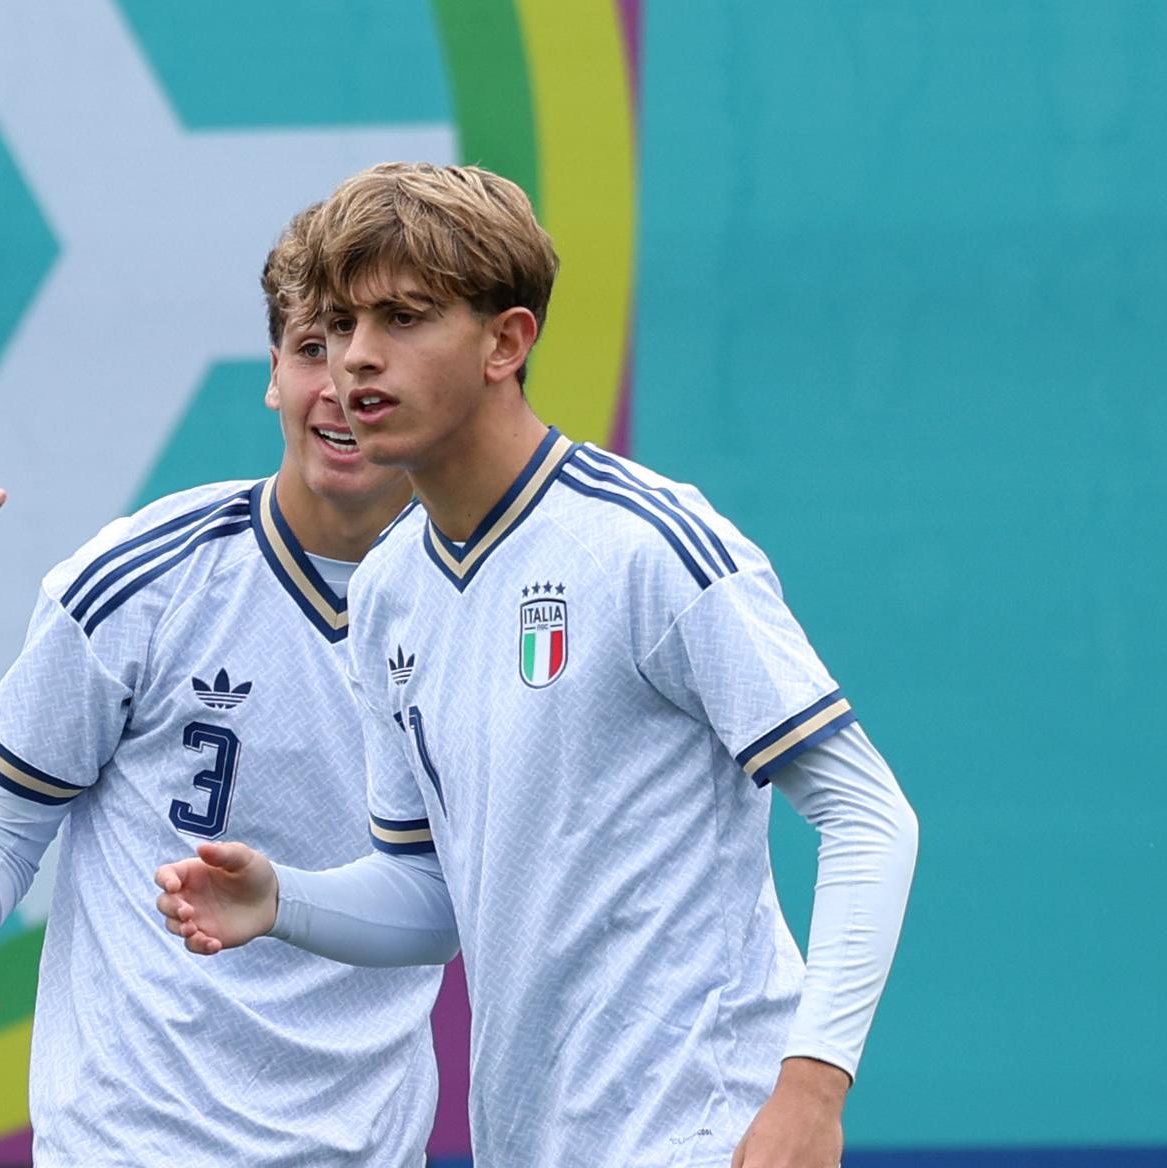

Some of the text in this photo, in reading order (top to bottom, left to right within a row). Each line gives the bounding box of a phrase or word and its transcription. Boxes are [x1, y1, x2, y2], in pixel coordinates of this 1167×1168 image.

[523, 605, 563, 624] ITALIA
[169, 721, 241, 840] 3
[393, 705, 448, 822] 1
